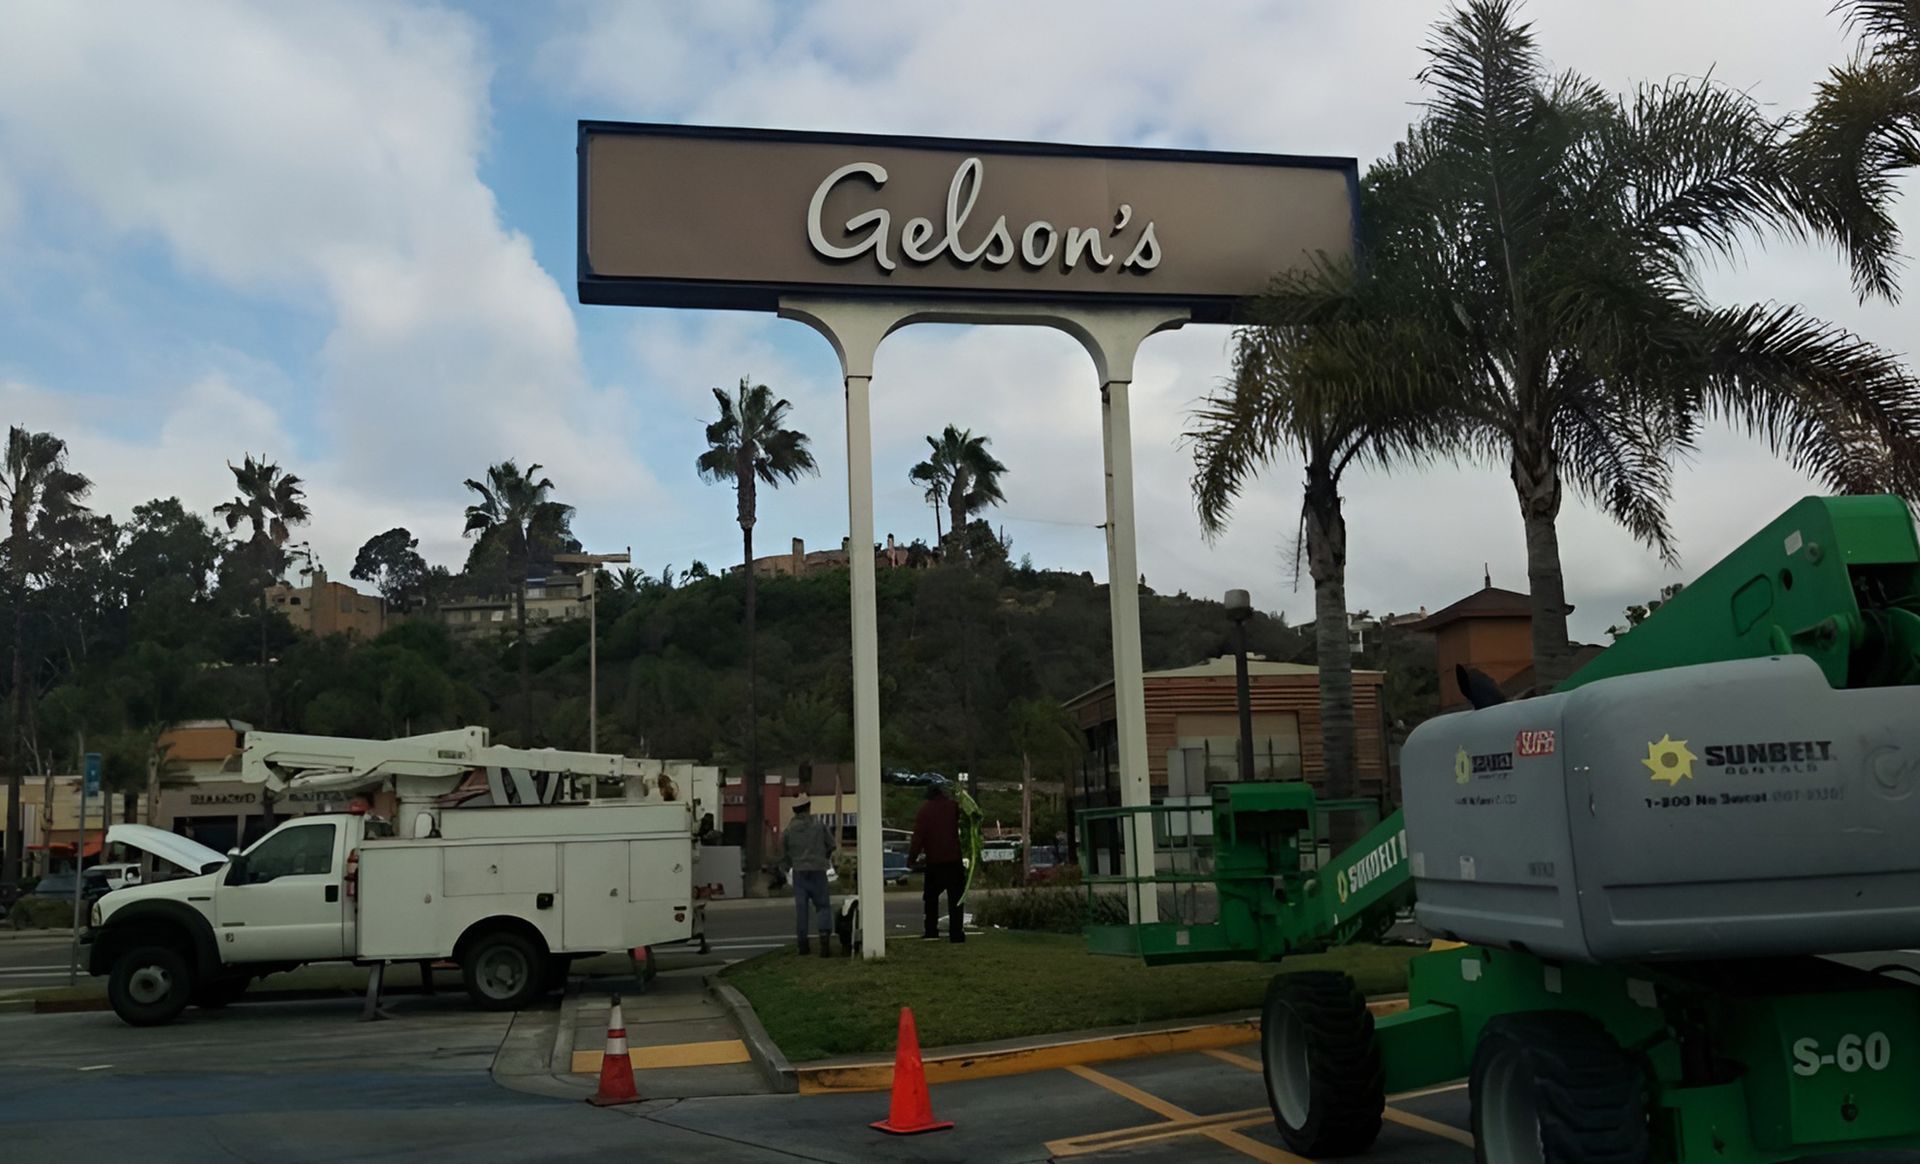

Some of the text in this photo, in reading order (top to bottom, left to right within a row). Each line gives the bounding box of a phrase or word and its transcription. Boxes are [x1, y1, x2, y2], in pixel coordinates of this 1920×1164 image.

[807, 157, 1162, 270] Gelson's
[1704, 741, 1831, 766] SUNBELT
[1792, 1031, 1891, 1076] S-60
